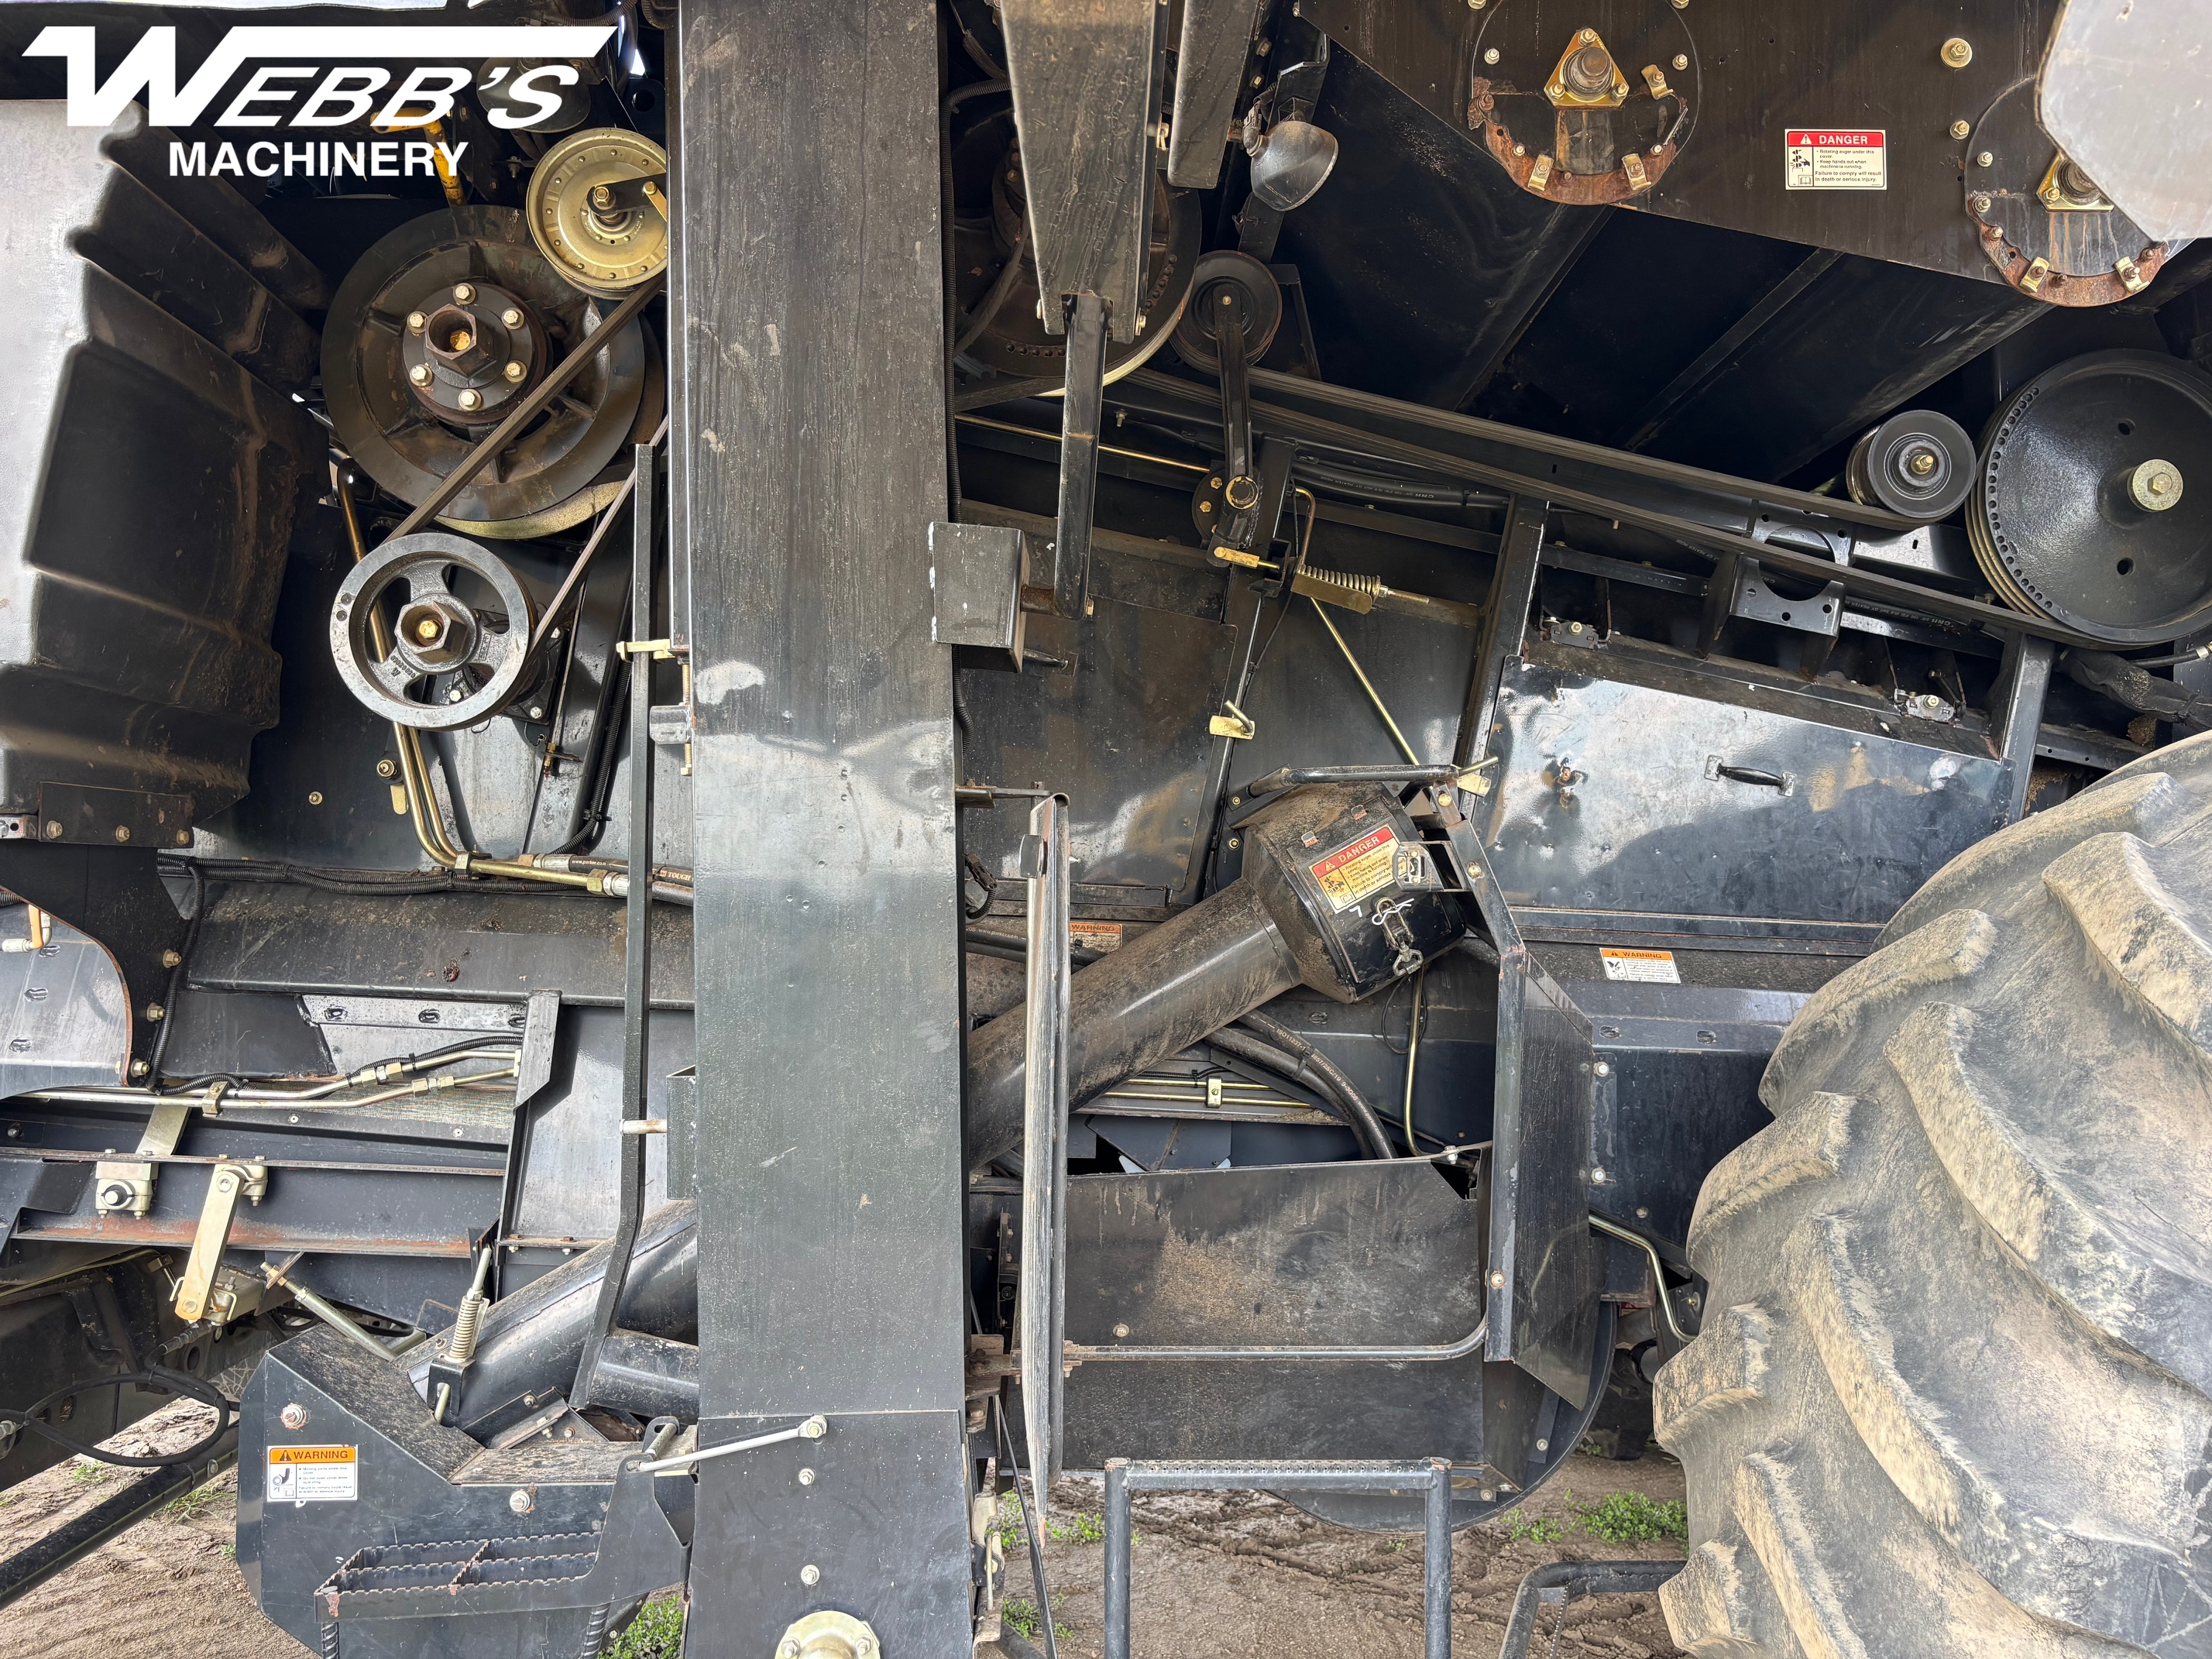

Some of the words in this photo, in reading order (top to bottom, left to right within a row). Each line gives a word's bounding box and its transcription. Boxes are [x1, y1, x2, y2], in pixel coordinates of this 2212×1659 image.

[1819, 135, 1868, 144] DANGER
[1851, 601, 1870, 610] HEATER
[1338, 835, 1380, 864] DANGER
[1345, 859, 1361, 871] Rotating
[1361, 854, 1372, 862] auger
[668, 872, 691, 881] TOUGH
[1351, 879, 1366, 890] Failure
[1370, 869, 1386, 879] comply
[1352, 872, 1368, 882] machine
[1358, 883, 1371, 892] death
[1376, 872, 1391, 882] serious
[1276, 1028, 1306, 1051] ISO11237-1
[1358, 1101, 1383, 1139] www.parker.com
[293, 1451, 348, 1459] WARNING
